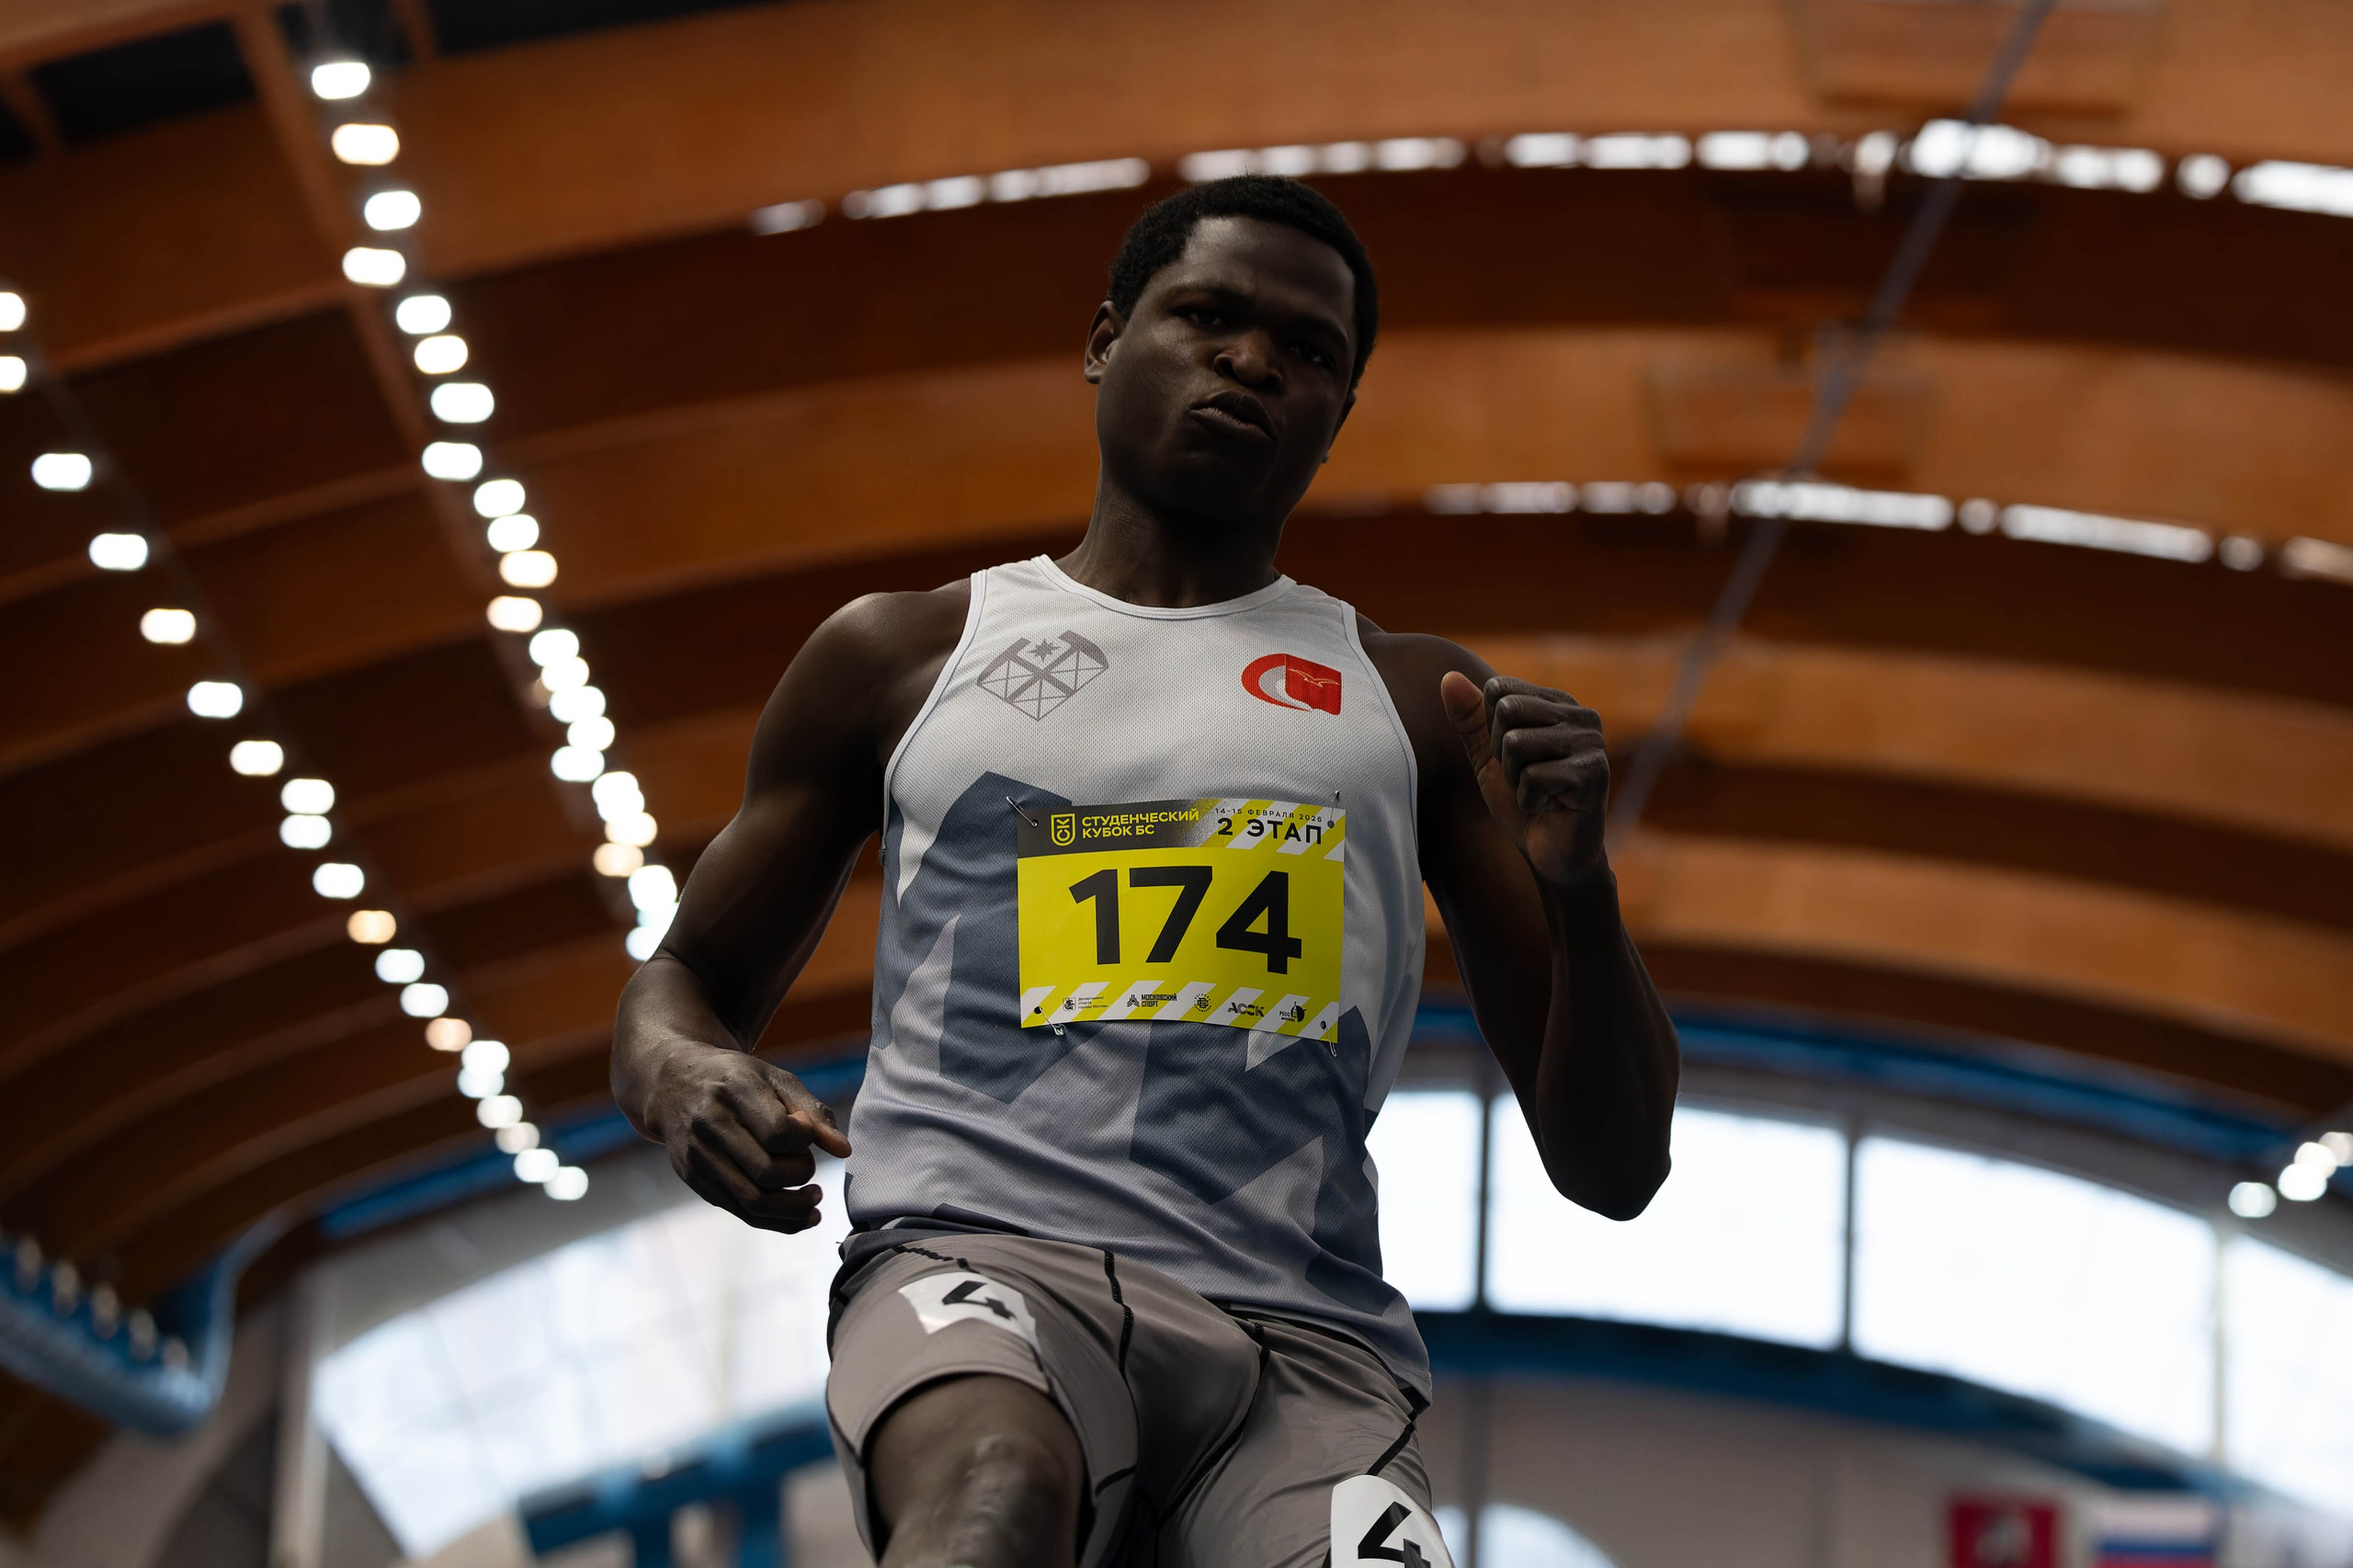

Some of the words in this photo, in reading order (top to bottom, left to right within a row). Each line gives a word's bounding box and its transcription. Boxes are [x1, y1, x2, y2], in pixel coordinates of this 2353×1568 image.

[1082, 808, 1199, 827] СТУДЕНЧЕСКИЙ
[1247, 809, 1294, 819] ФЕВРАЛЯ
[1299, 813, 1323, 823] 2026
[1082, 825, 1132, 839] КУБОК
[1135, 824, 1155, 835] БС
[1217, 817, 1233, 836] 2
[1246, 818, 1322, 845] ЭТАП
[1068, 866, 1302, 975] 174
[1141, 993, 1177, 1002] МОСКОВСКИЙ
[941, 1279, 1017, 1320] 4
[1358, 1501, 1432, 1568] 4
